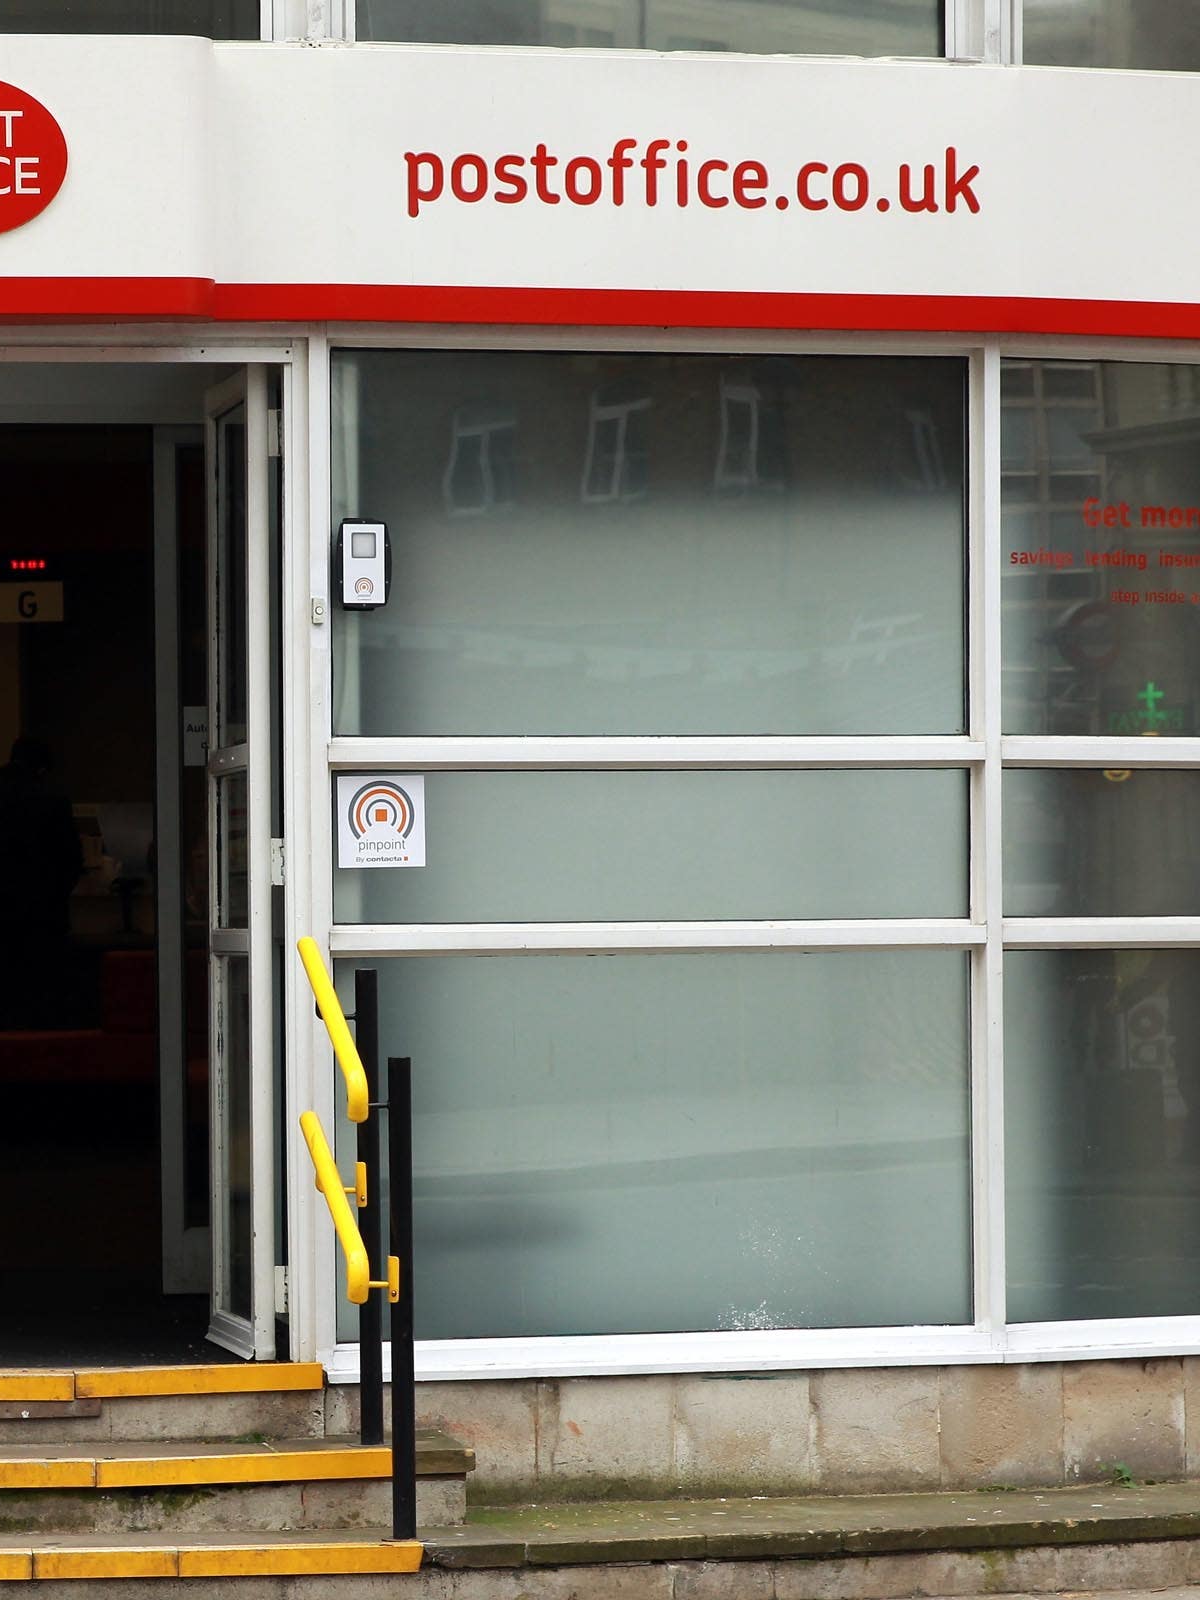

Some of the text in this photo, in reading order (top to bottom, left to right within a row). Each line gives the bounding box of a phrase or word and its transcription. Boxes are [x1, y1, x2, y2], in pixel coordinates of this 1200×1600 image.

[404, 138, 980, 218] postoffice.co.uk
[1083, 497, 1131, 528] Get
[1010, 549, 1073, 569] savings
[1085, 549, 1147, 570] lending
[17, 590, 38, 618] G
[1145, 589, 1185, 603] inside
[358, 839, 406, 853] pinpoint
